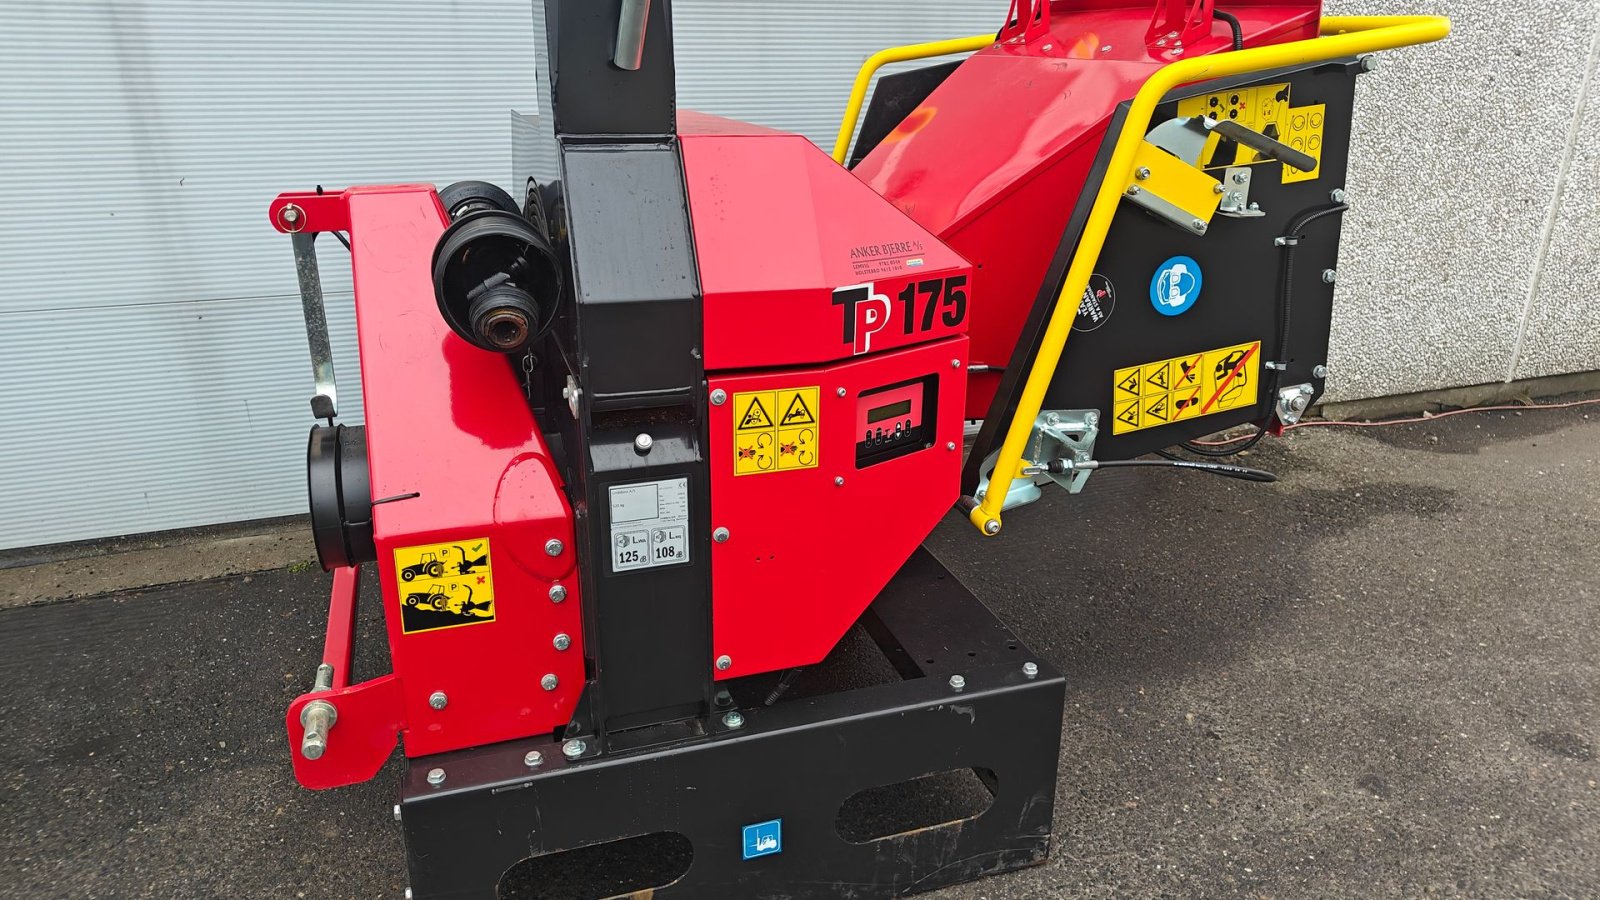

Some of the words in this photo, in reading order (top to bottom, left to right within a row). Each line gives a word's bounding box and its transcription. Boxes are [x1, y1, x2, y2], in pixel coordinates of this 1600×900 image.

[850, 245, 881, 258] ANKER
[881, 241, 912, 256] BJERRE
[832, 281, 891, 355] TP
[899, 275, 967, 335] 175
[442, 549, 448, 557] P
[619, 550, 639, 563] 125
[656, 545, 675, 559] 108
